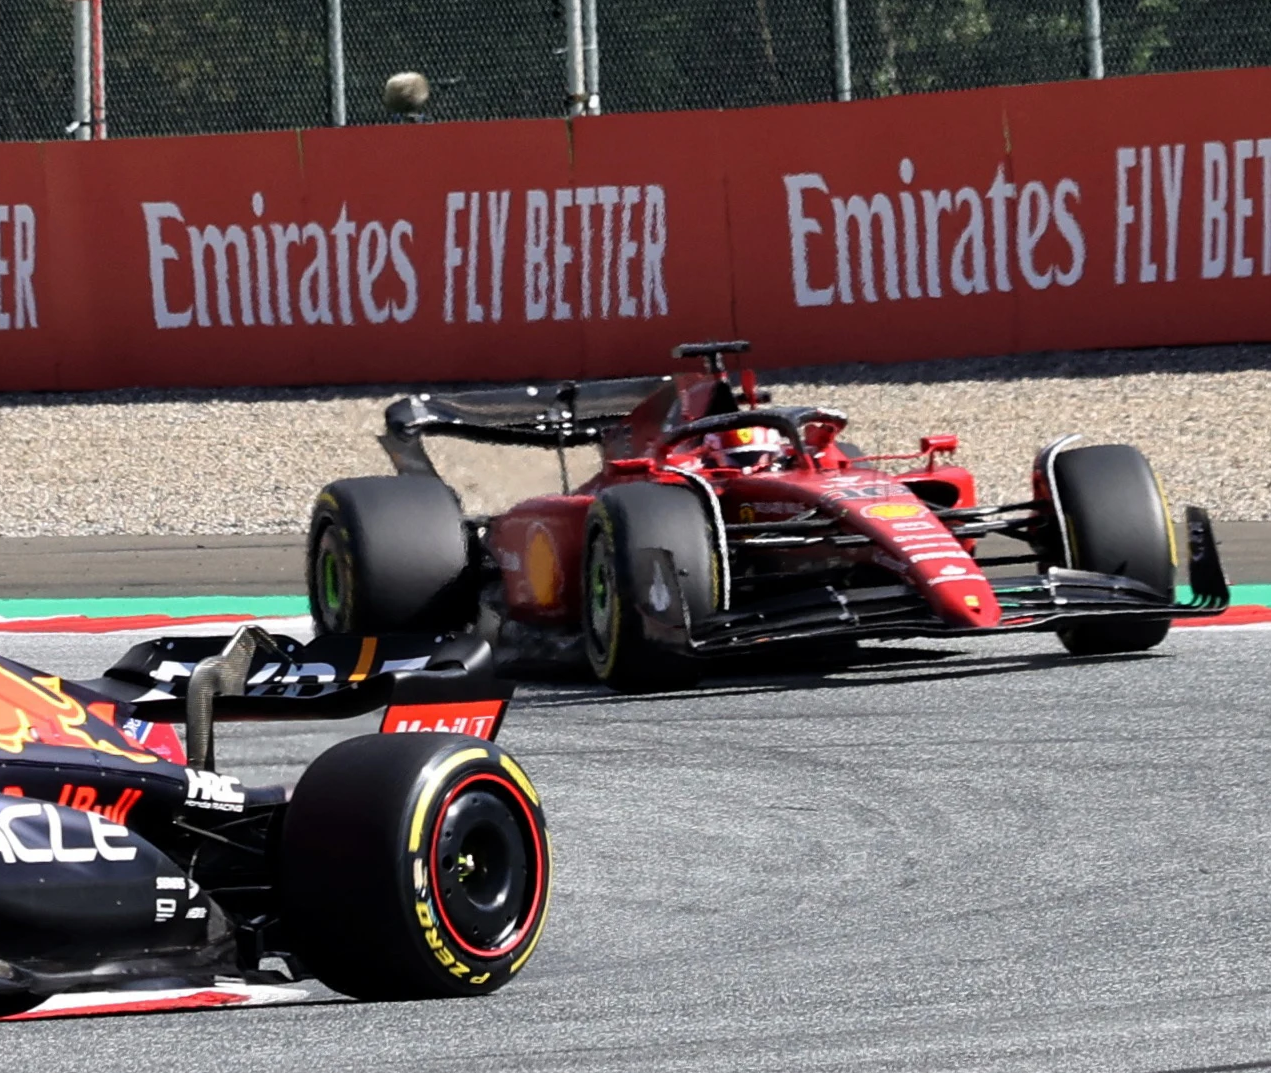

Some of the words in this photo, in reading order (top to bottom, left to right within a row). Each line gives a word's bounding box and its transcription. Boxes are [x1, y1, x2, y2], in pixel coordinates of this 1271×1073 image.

[142, 192, 417, 328] Emirates
[445, 191, 510, 321] FLY
[525, 185, 667, 320] BETTER
[784, 159, 1085, 306] Emirates
[1116, 144, 1184, 283] FLY
[415, 901, 471, 978] ZERO
